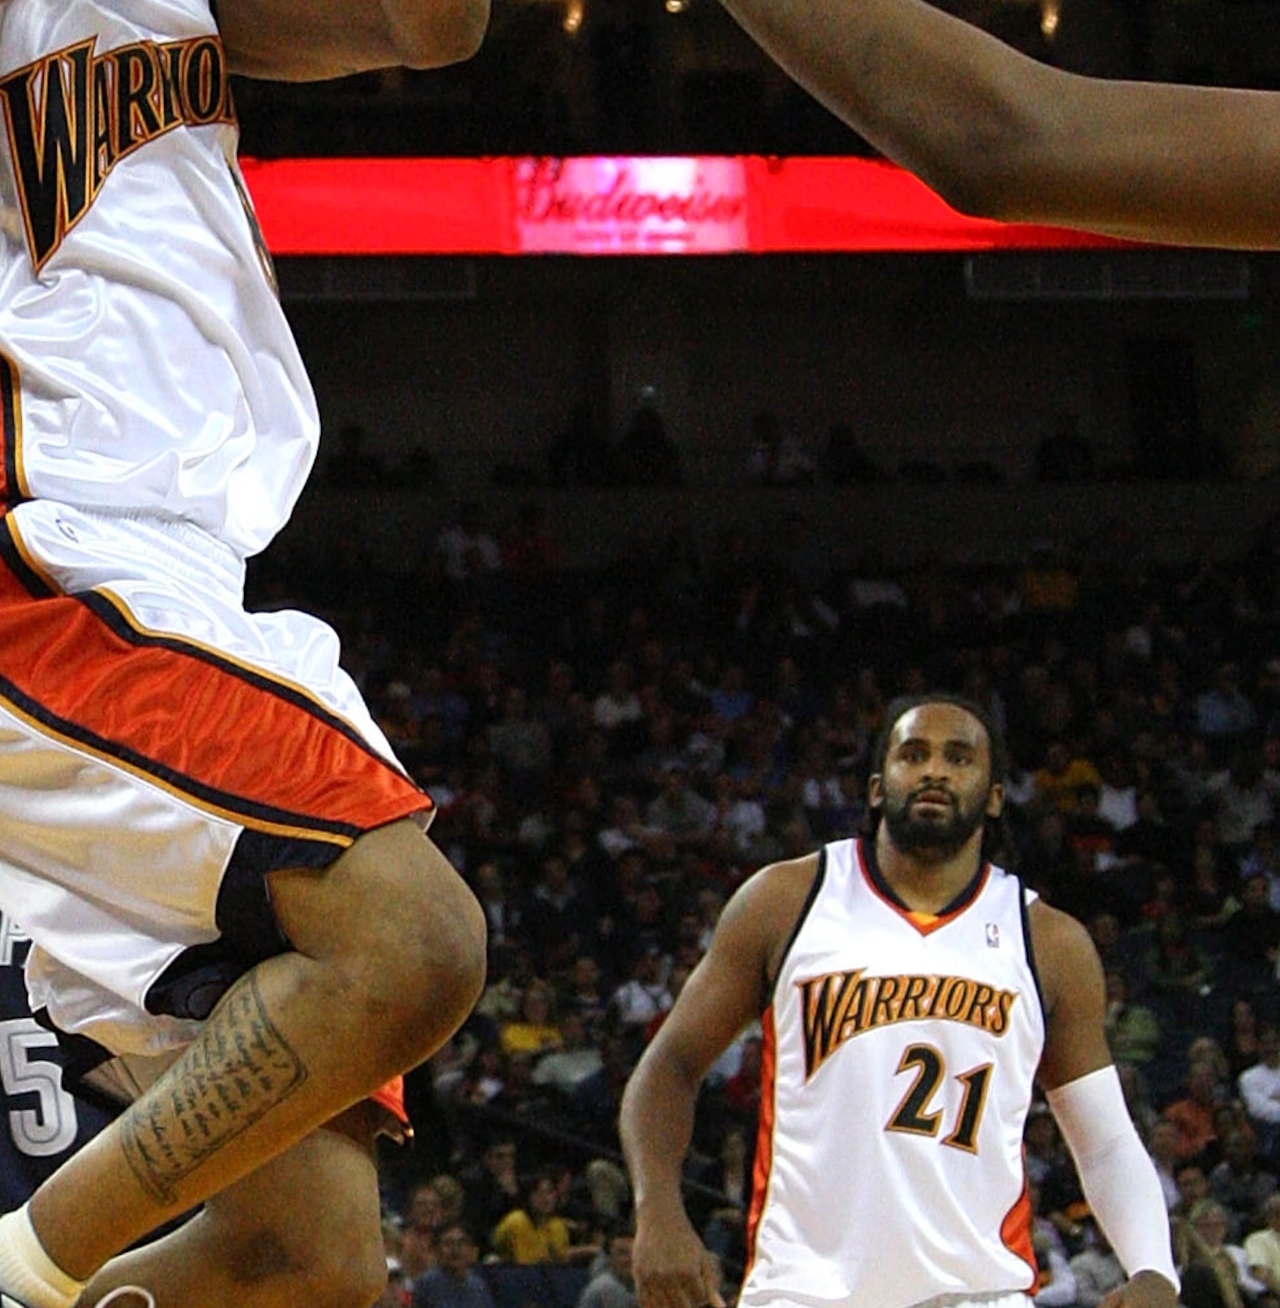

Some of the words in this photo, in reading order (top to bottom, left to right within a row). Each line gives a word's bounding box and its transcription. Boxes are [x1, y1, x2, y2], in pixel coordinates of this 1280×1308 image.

[519, 156, 741, 221] Budweiser
[794, 967, 1020, 1087] WARRIORS
[883, 1042, 994, 1156] 21
